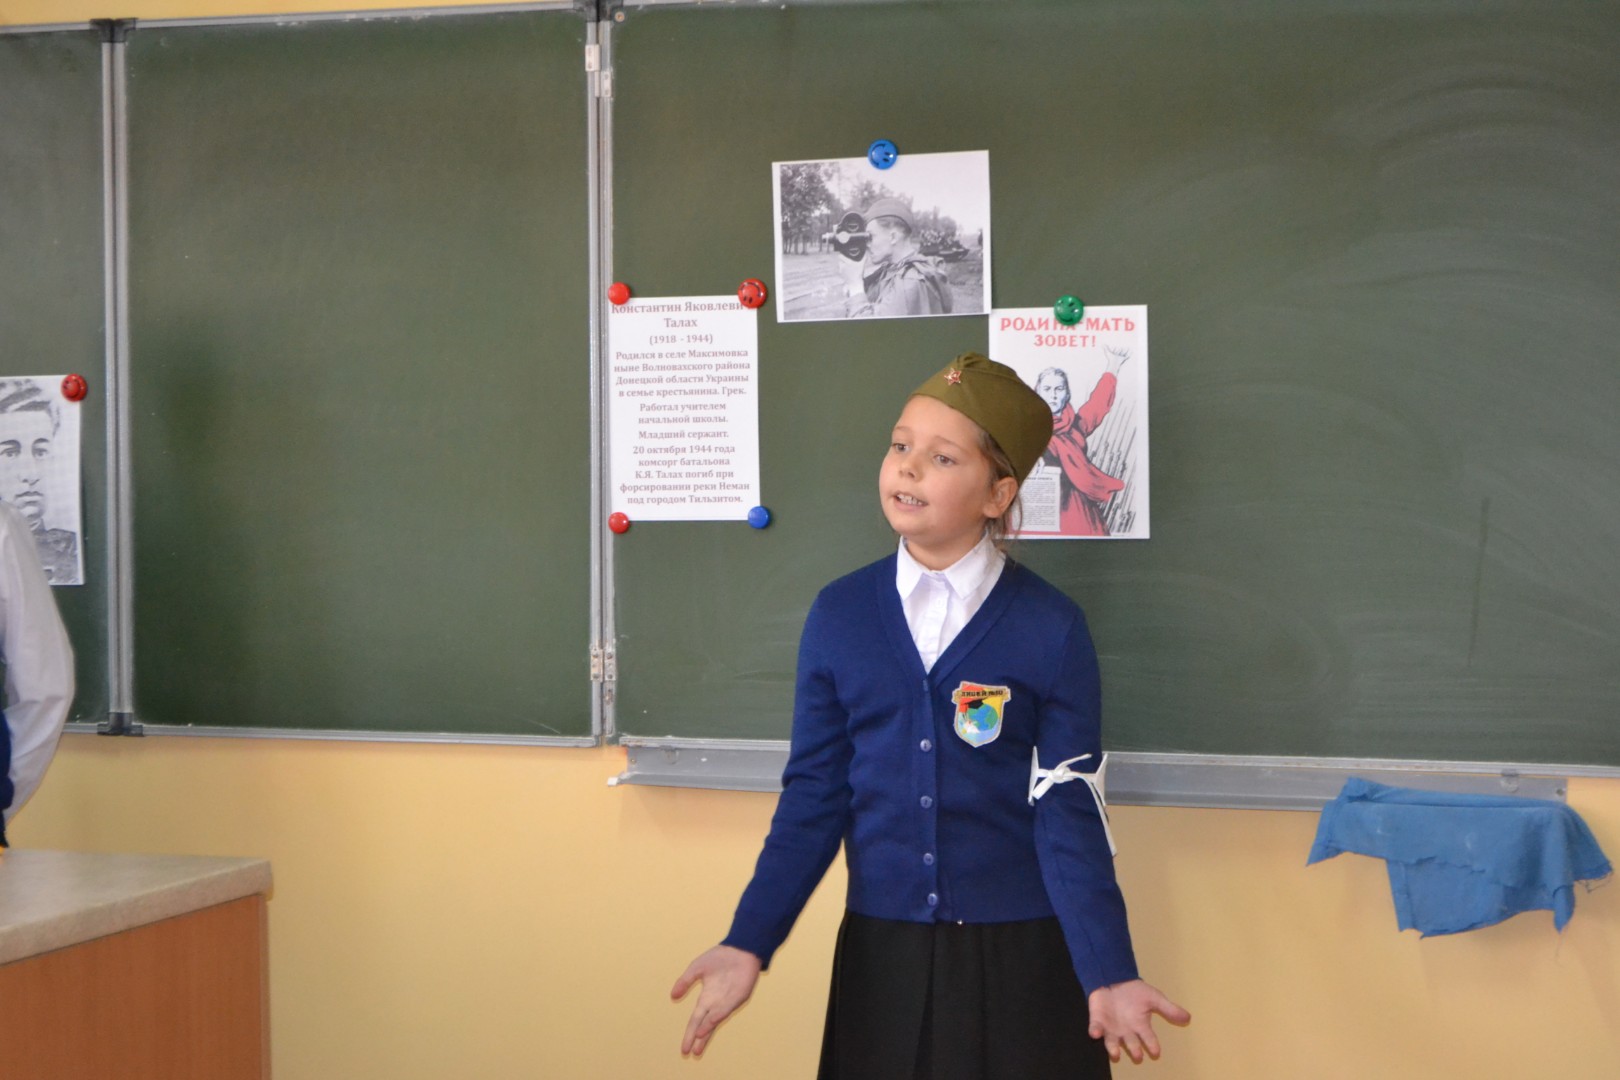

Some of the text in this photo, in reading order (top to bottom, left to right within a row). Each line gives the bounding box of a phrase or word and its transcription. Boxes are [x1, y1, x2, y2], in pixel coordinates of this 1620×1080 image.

[611, 301, 744, 313] Константин Яковлеви
[663, 317, 698, 328] Талах
[649, 335, 677, 346] (1918
[686, 333, 714, 345] 1944)
[1033, 334, 1096, 348] ЗОВЕТ!
[615, 351, 656, 361] Родился
[688, 350, 748, 358] Максимовка
[642, 362, 713, 372] Волновахского
[715, 361, 751, 373] района
[615, 374, 749, 386] Донецкой области Украины
[626, 389, 654, 397] семье
[656, 388, 720, 399] крестьянина.
[722, 387, 747, 398] Грек.
[640, 402, 726, 413] Работал учителем
[638, 415, 729, 424] начальной школы.
[638, 430, 729, 441] Младший сержант.
[632, 445, 736, 456] 20 октября 1944 года
[638, 457, 730, 468] комсорг батальона
[656, 470, 683, 479] Талах
[685, 469, 714, 479] погиб
[715, 470, 734, 480] при
[619, 481, 750, 494] форсировании реки Неман
[627, 494, 743, 506] под городом Тильзитом.
